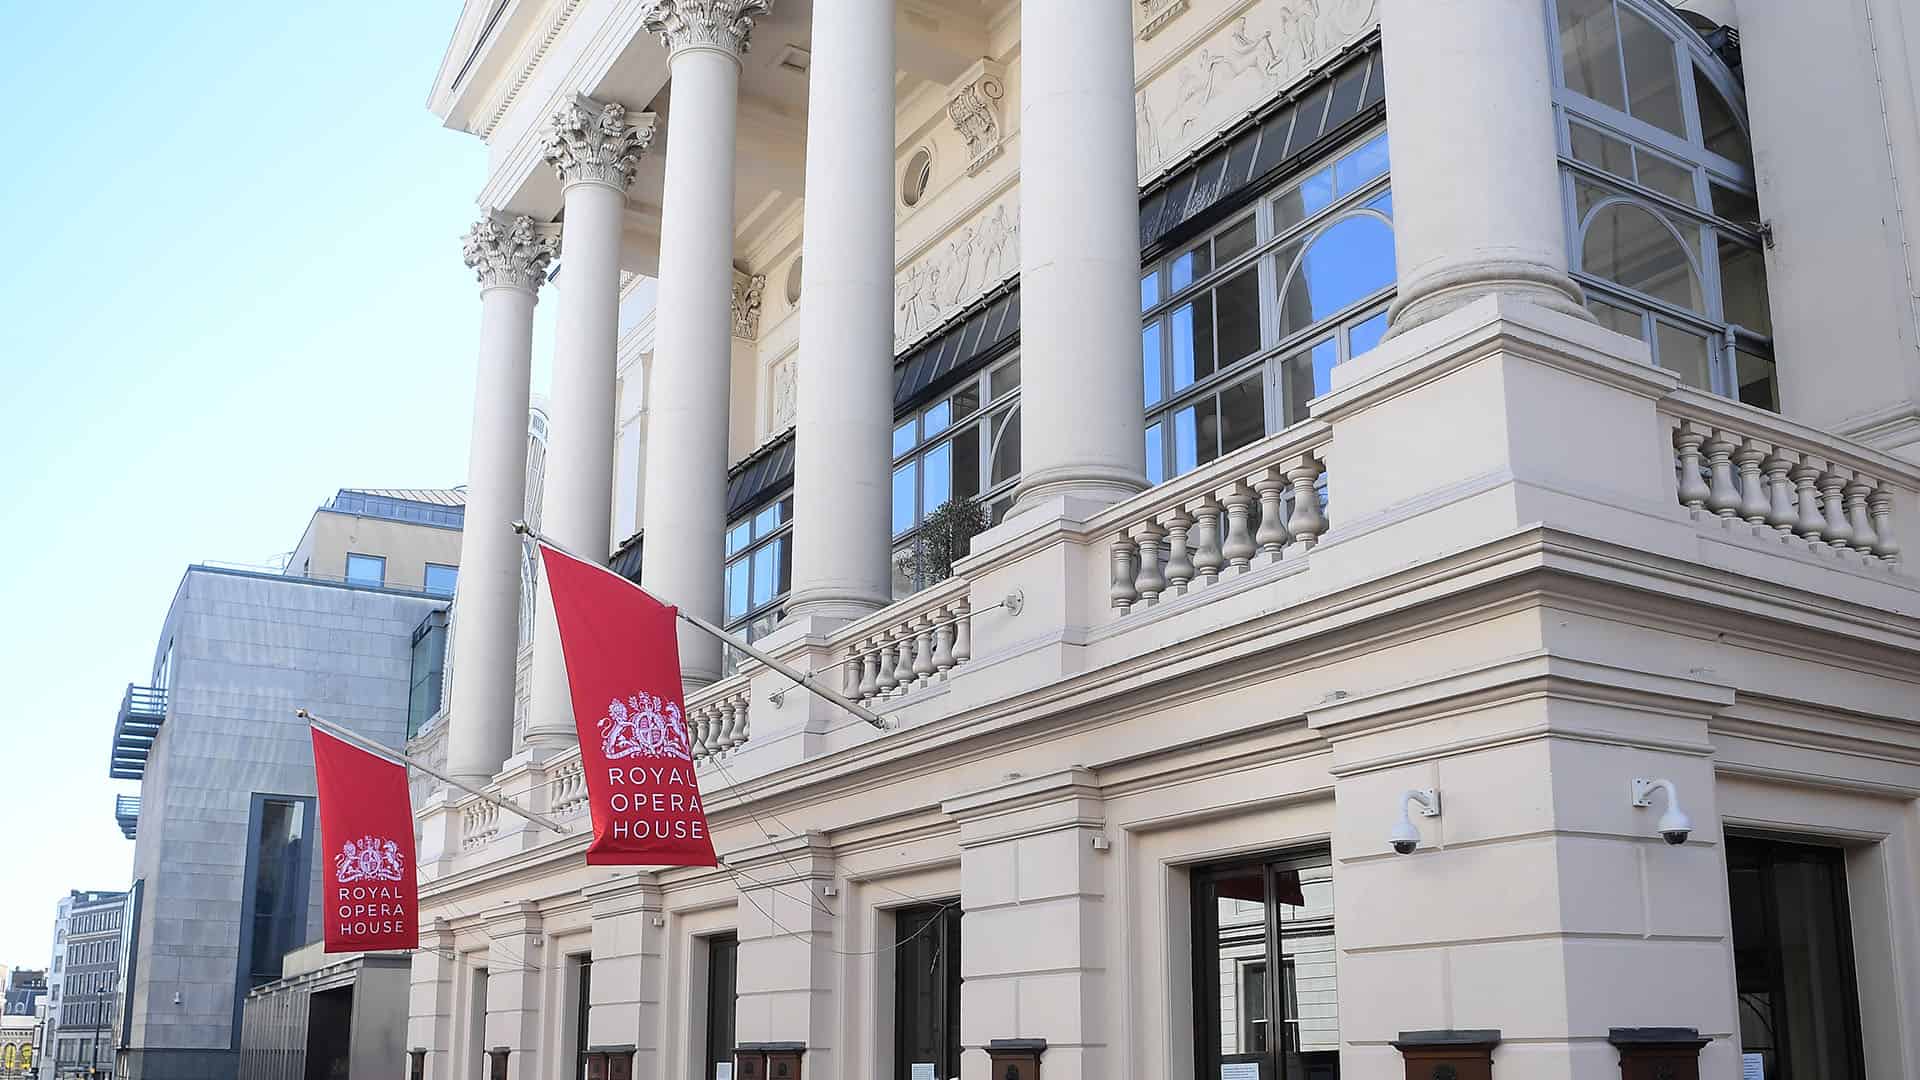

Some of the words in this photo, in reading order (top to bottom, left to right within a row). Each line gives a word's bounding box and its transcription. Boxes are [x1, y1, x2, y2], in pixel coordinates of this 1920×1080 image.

[608, 767, 697, 788] ROYAL
[611, 793, 701, 813] OPERA
[614, 820, 704, 839] HOUSE
[339, 887, 403, 901] ROYAL
[339, 903, 404, 918] OPERA
[341, 920, 404, 936] HOUSE
